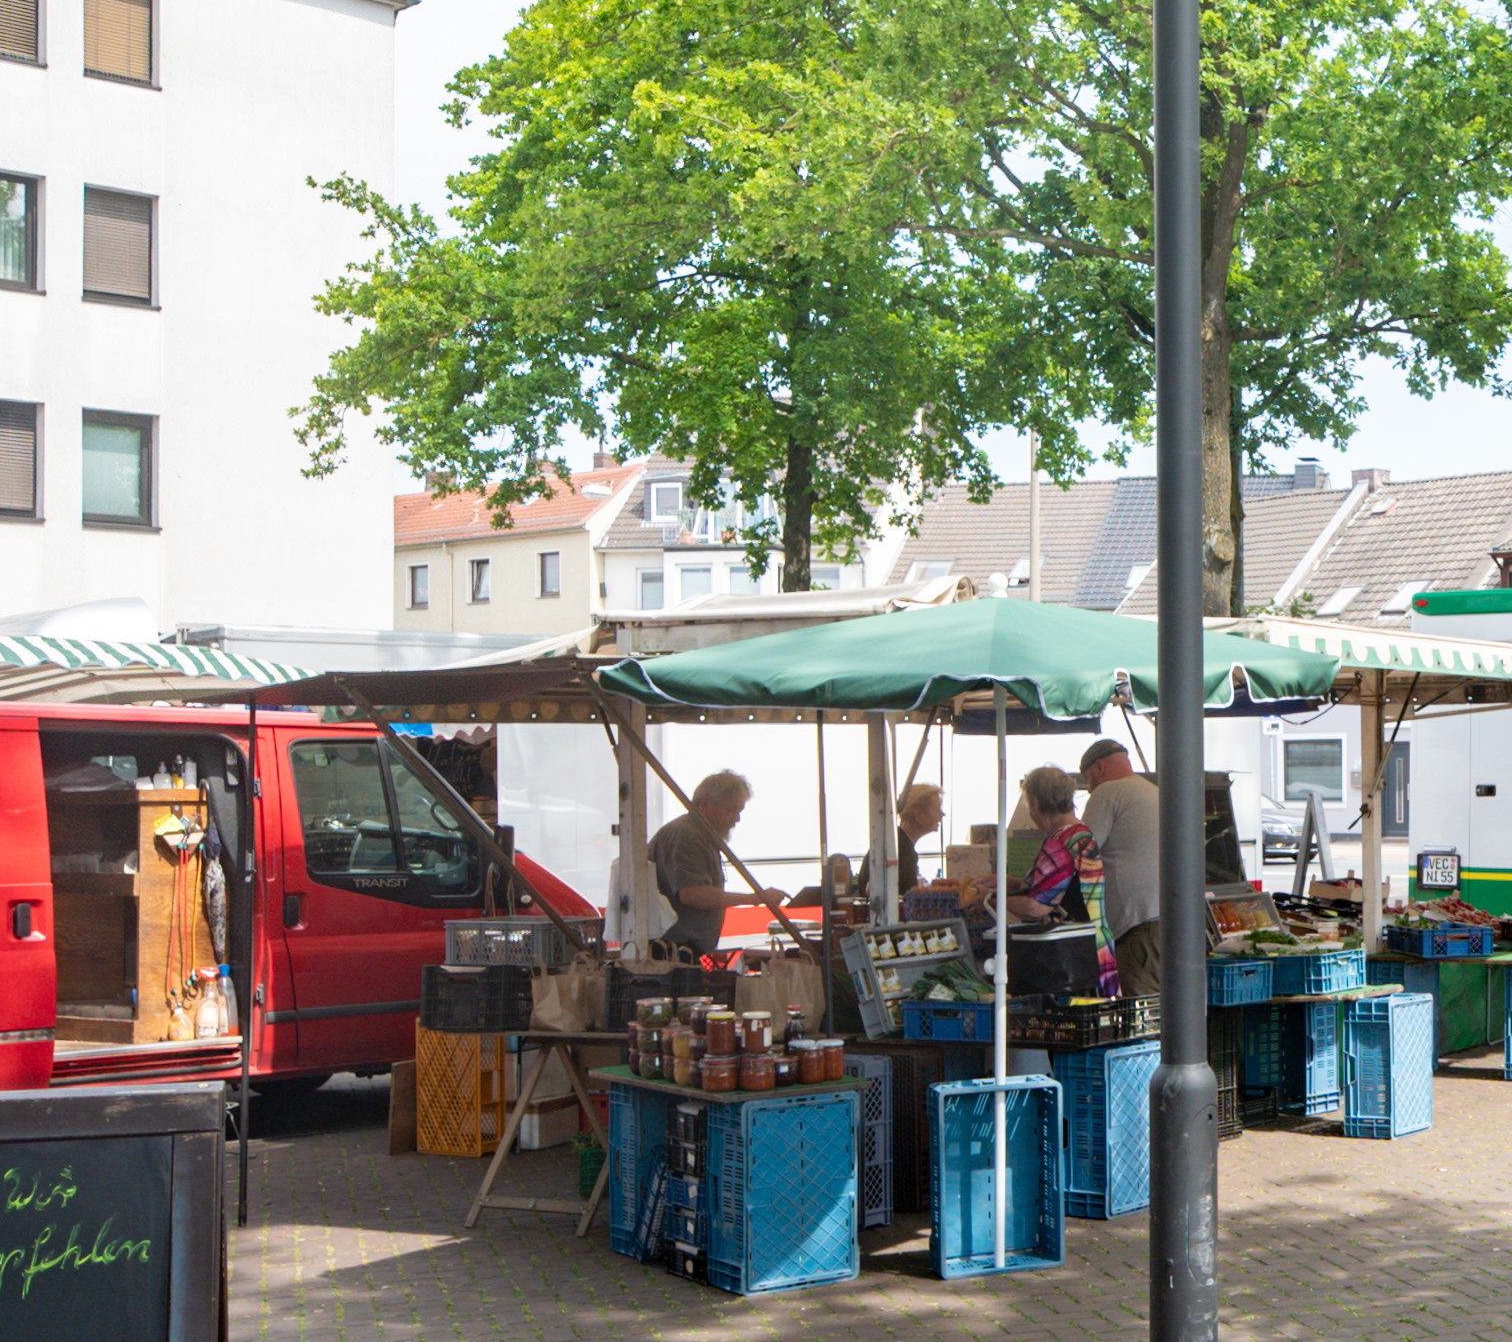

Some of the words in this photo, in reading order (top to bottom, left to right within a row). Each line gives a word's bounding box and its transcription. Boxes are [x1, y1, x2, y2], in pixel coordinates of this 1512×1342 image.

[1429, 858, 1449, 870] VEC
[353, 878, 408, 888] TRANSIT
[1441, 871, 1454, 883] 55
[2, 1164, 79, 1211] Wir
